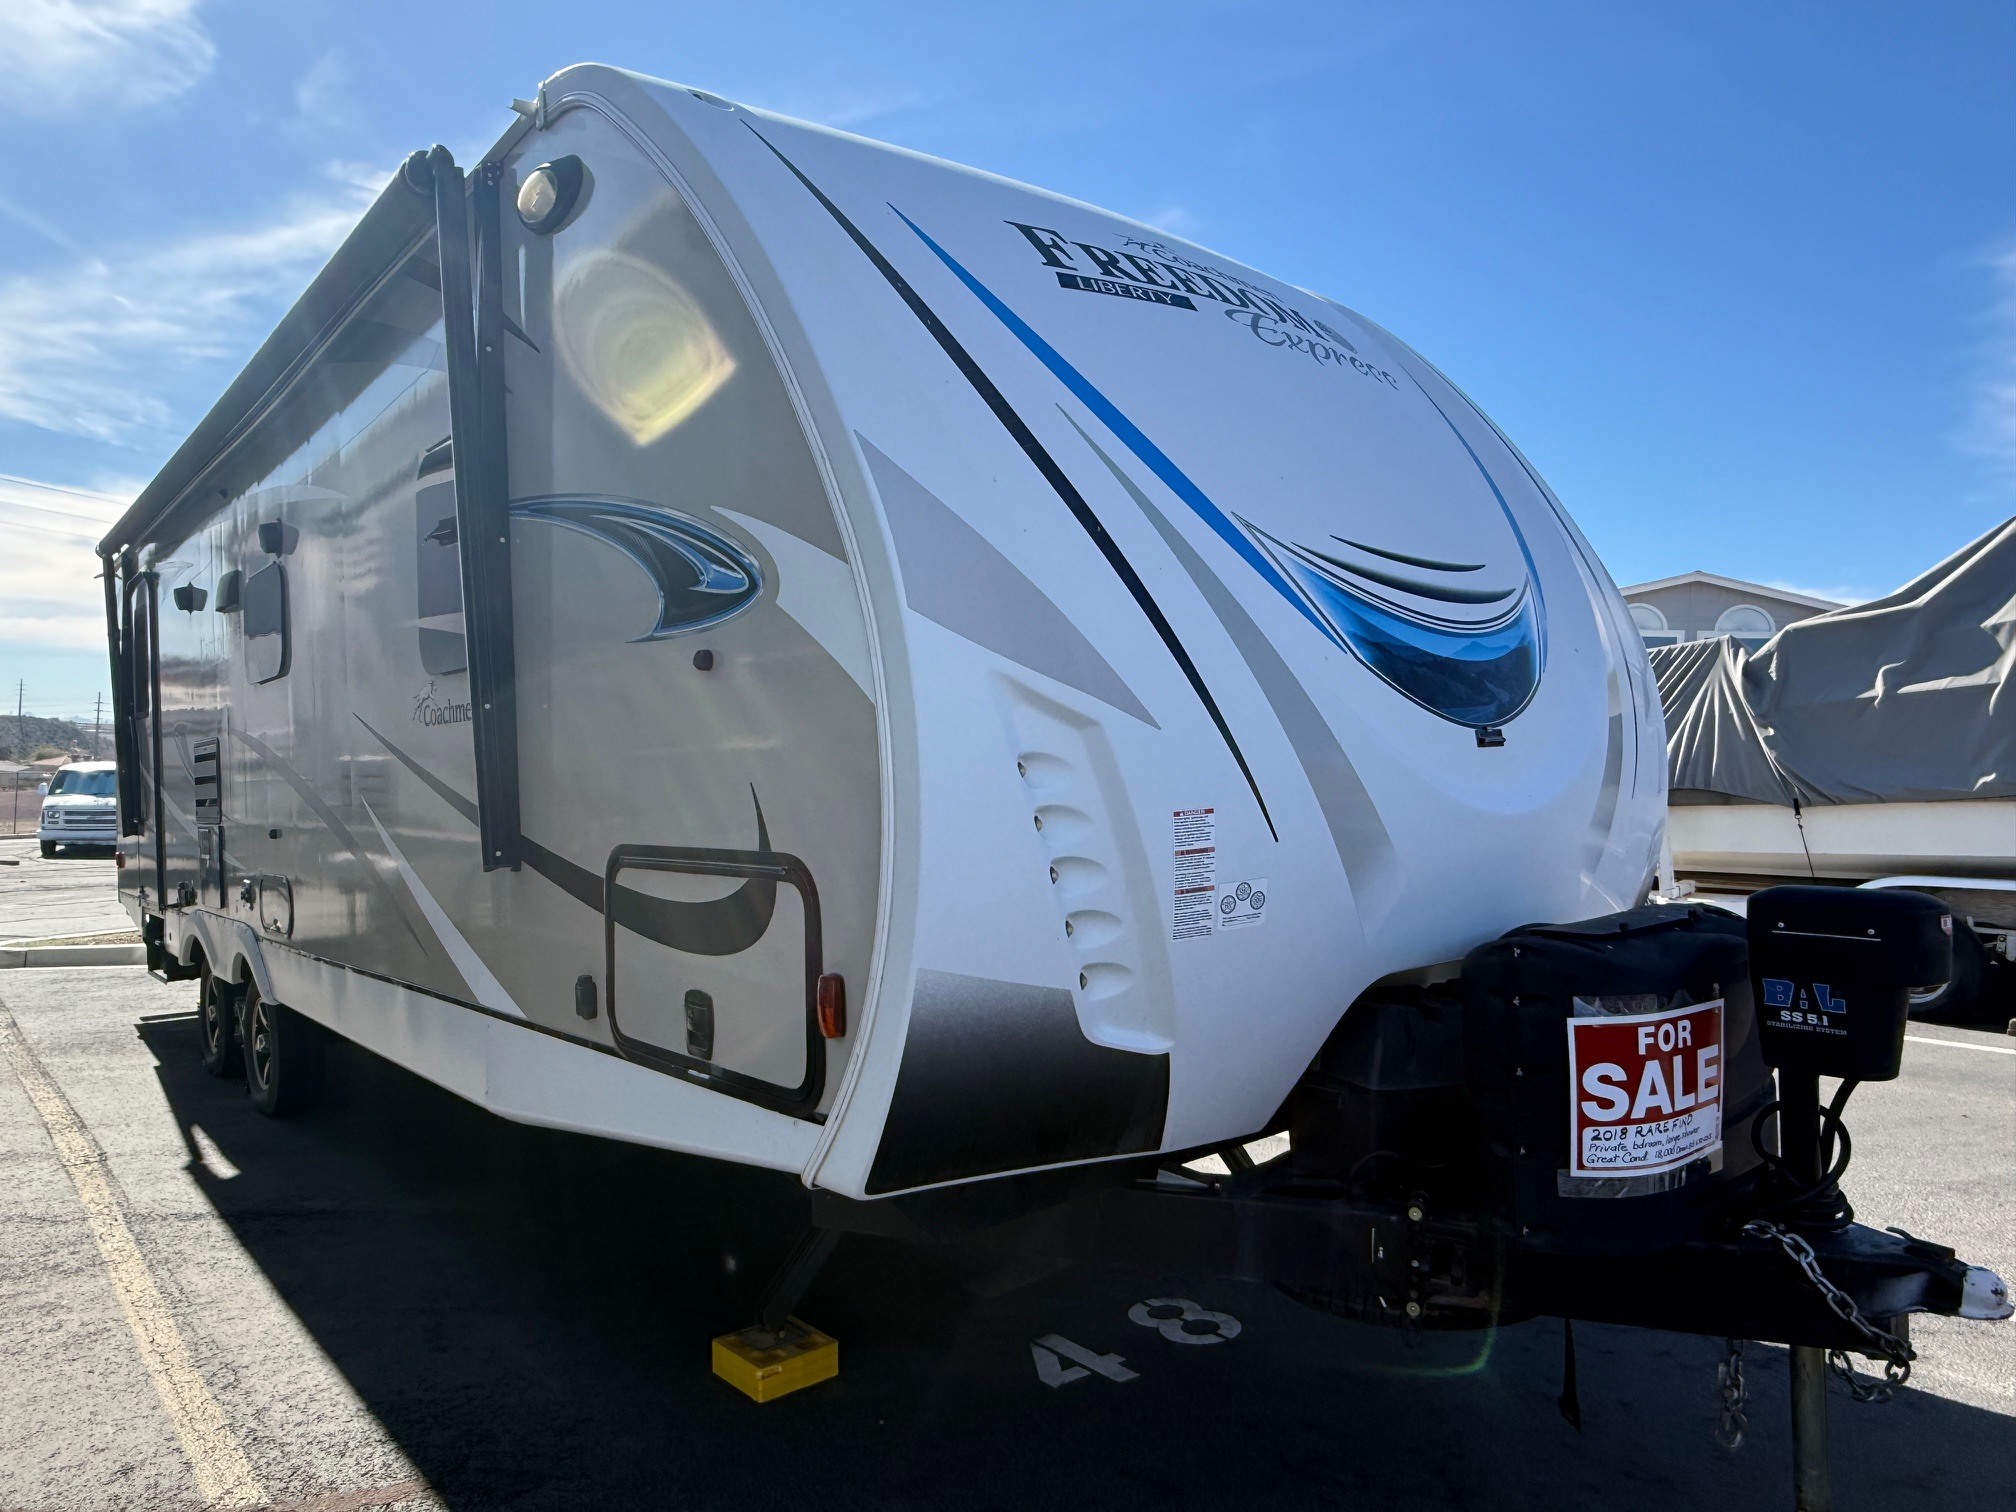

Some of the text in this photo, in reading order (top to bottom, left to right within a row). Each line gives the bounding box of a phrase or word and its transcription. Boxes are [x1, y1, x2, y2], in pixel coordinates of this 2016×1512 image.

[1003, 220, 1332, 342] FREEDOM
[1075, 276, 1175, 304] LIBERTY
[1224, 308, 1400, 392] Express
[423, 698, 473, 727] Coachme
[1762, 978, 1847, 1014] BAL
[1766, 1020, 1847, 1036] STABILIZING SYSTEM
[1780, 1010, 1829, 1026] SS 5.1
[1637, 1019, 1692, 1056] FOR
[1580, 1043, 1719, 1122] SALE
[1590, 1113, 1693, 1142] 2018 RARE FIND
[1586, 1152, 1620, 1164] Great
[1588, 1141, 1629, 1153] Private
